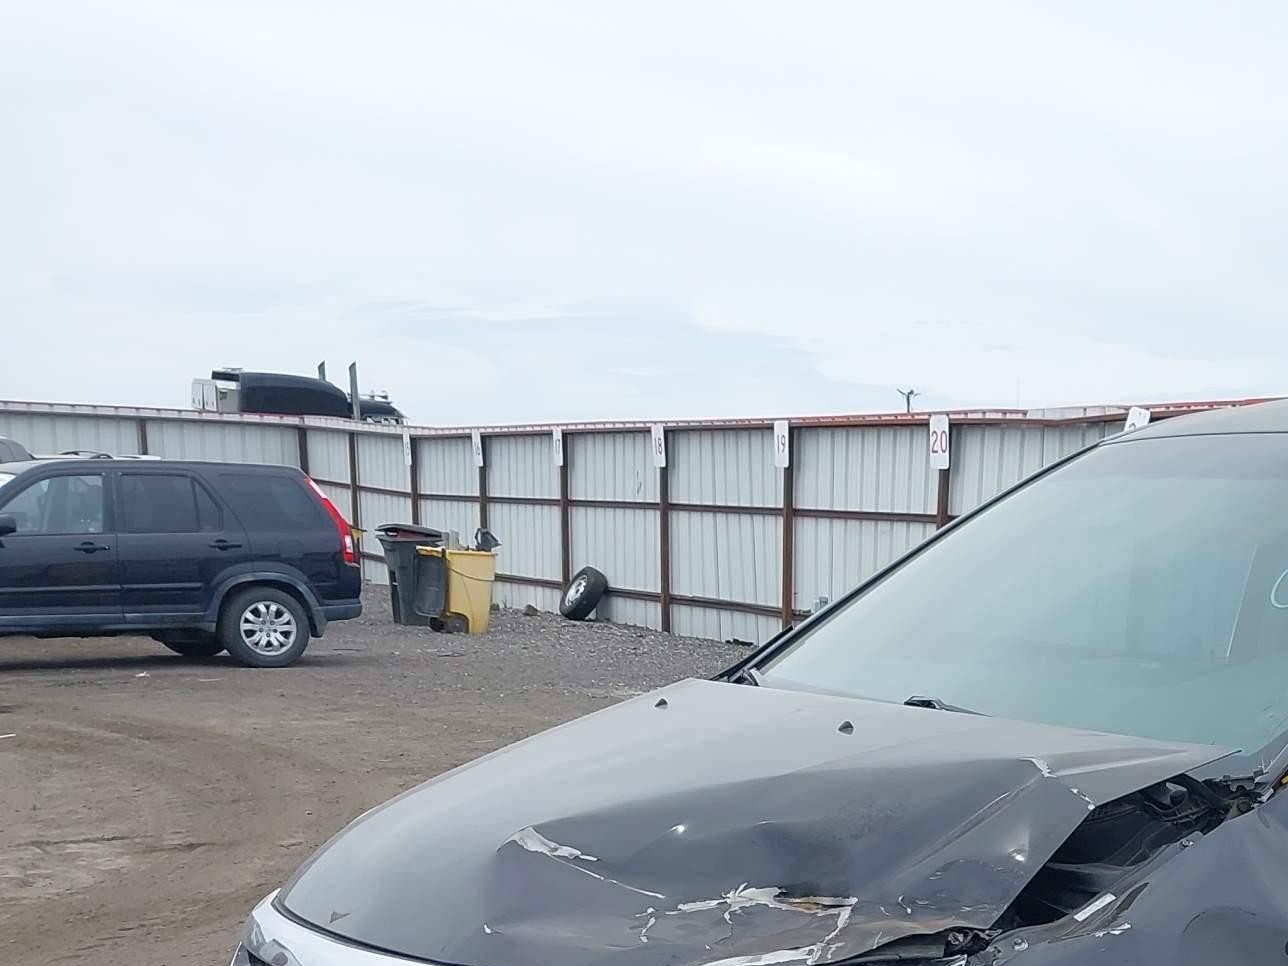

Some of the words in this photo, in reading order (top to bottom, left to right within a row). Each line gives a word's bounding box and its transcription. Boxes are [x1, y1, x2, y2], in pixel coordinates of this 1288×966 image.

[654, 437, 663, 456] 18
[776, 433, 786, 454] 19
[931, 430, 948, 454] 20
